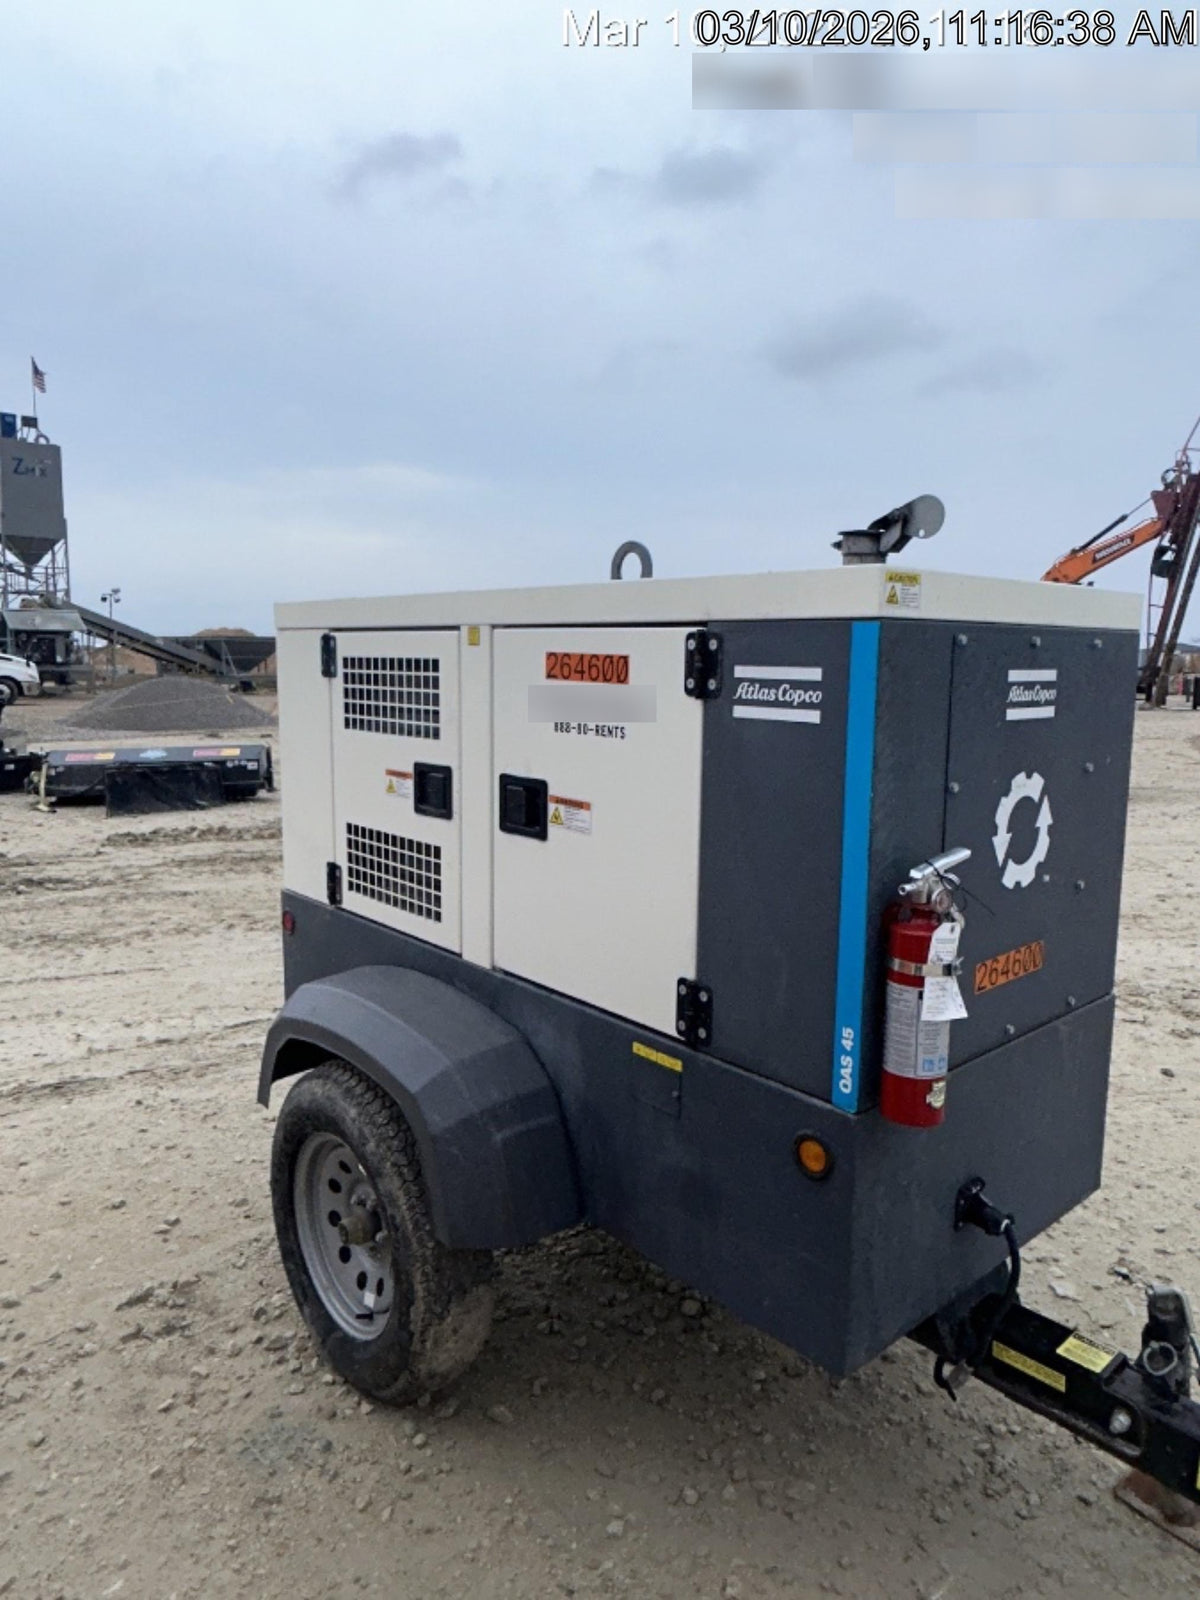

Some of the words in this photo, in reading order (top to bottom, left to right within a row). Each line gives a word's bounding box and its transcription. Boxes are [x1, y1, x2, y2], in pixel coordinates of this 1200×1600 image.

[545, 652, 629, 684] 264600
[732, 682, 777, 701] Atlas
[778, 683, 822, 706] Copco
[1006, 685, 1032, 703] Atlas
[1033, 684, 1057, 704] Copco
[976, 941, 1043, 992] 264600
[841, 1026, 855, 1052] 45
[839, 1054, 853, 1094] QAS
